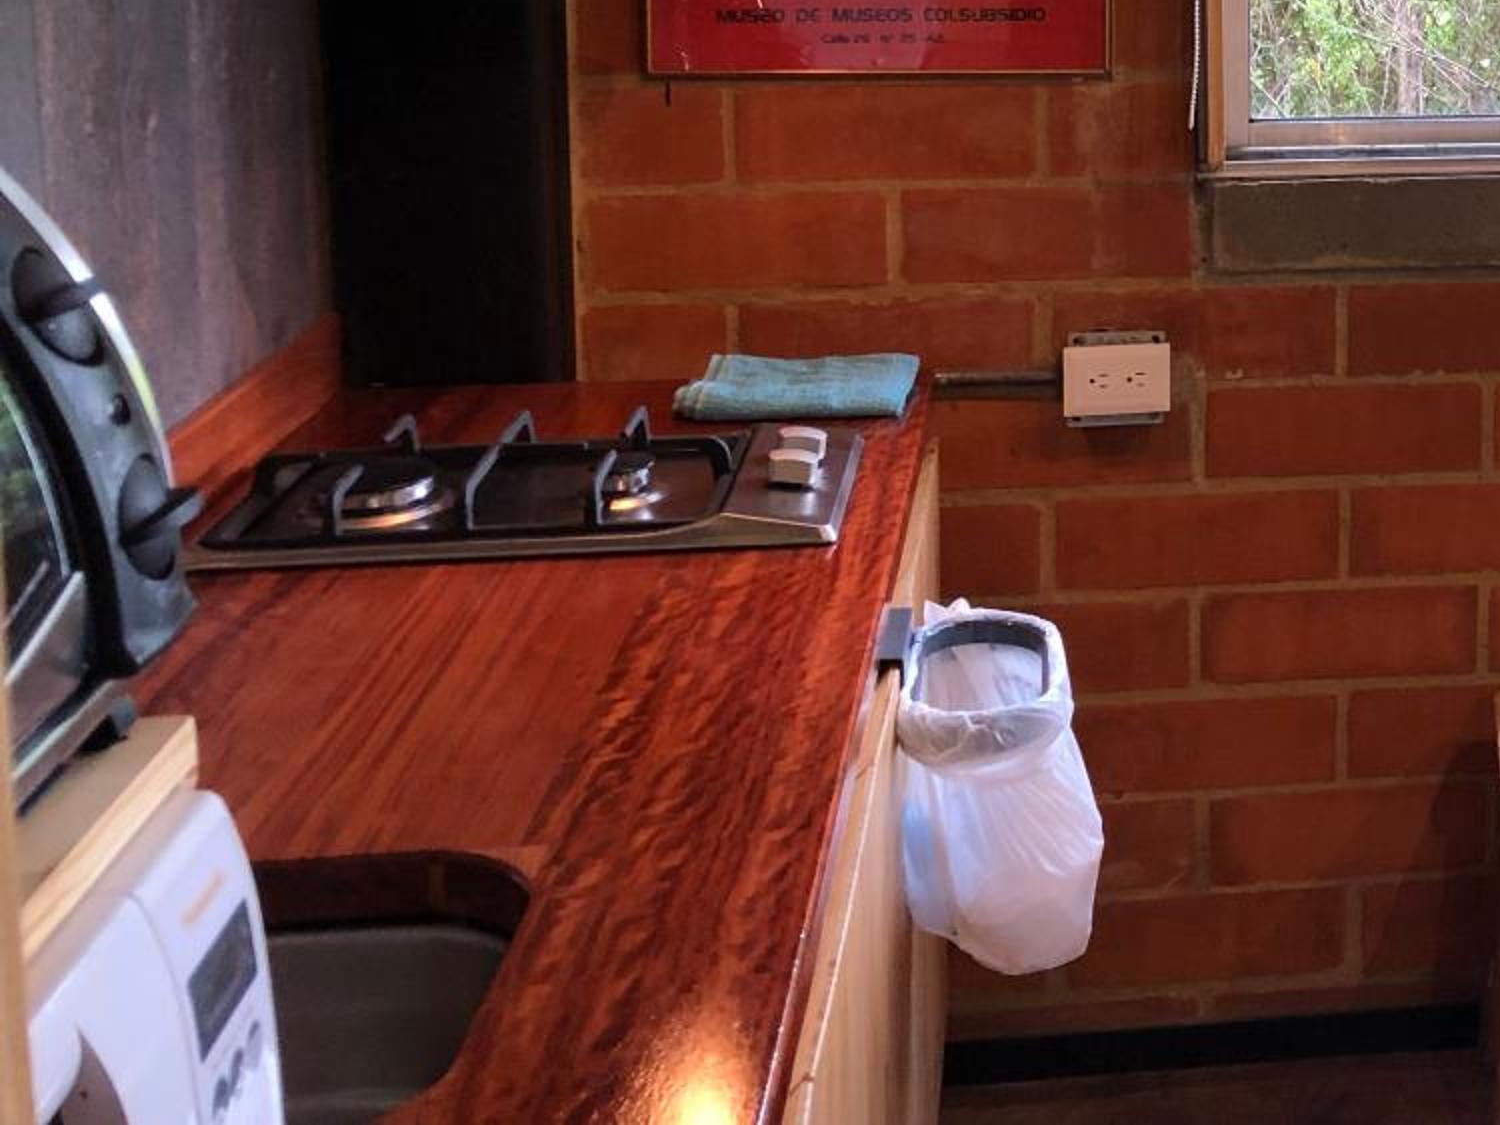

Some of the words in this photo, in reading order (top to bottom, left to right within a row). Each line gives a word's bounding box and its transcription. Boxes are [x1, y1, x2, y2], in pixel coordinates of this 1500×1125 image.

[716, 8, 785, 24] MUSEO
[796, 8, 821, 23] DE
[832, 8, 913, 23] MUSEOS
[923, 7, 1046, 23] COLSUBSIDIO
